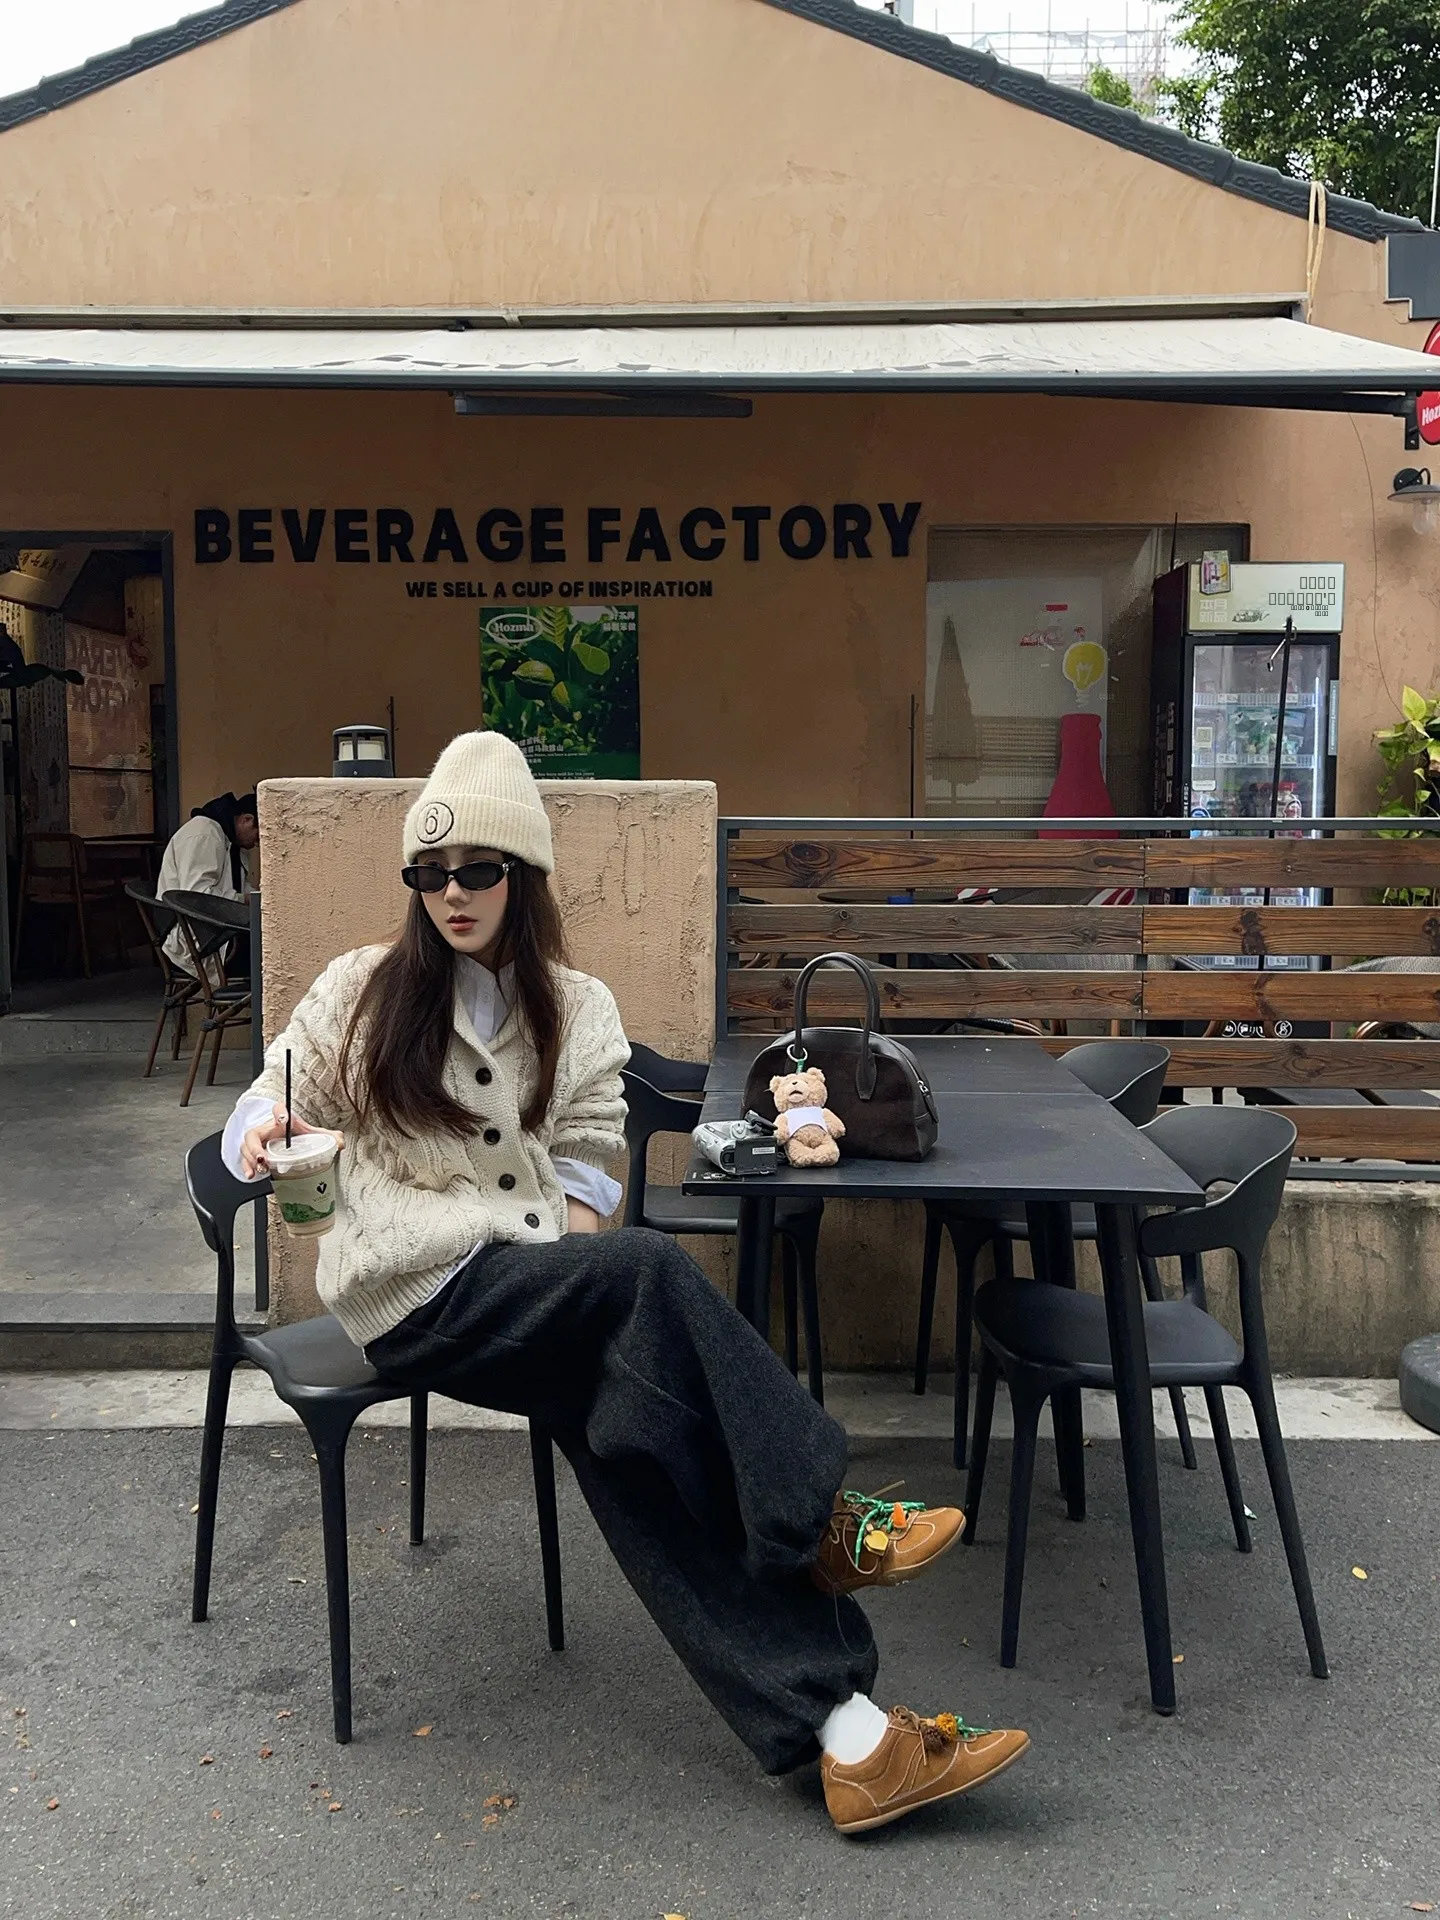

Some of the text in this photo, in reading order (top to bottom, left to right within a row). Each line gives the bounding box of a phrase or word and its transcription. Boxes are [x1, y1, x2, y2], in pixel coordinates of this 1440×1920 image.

[194, 502, 922, 564] BEVERAGE FACTORY
[406, 580, 713, 598] WE SELL A CUP OF INSPIRATION
